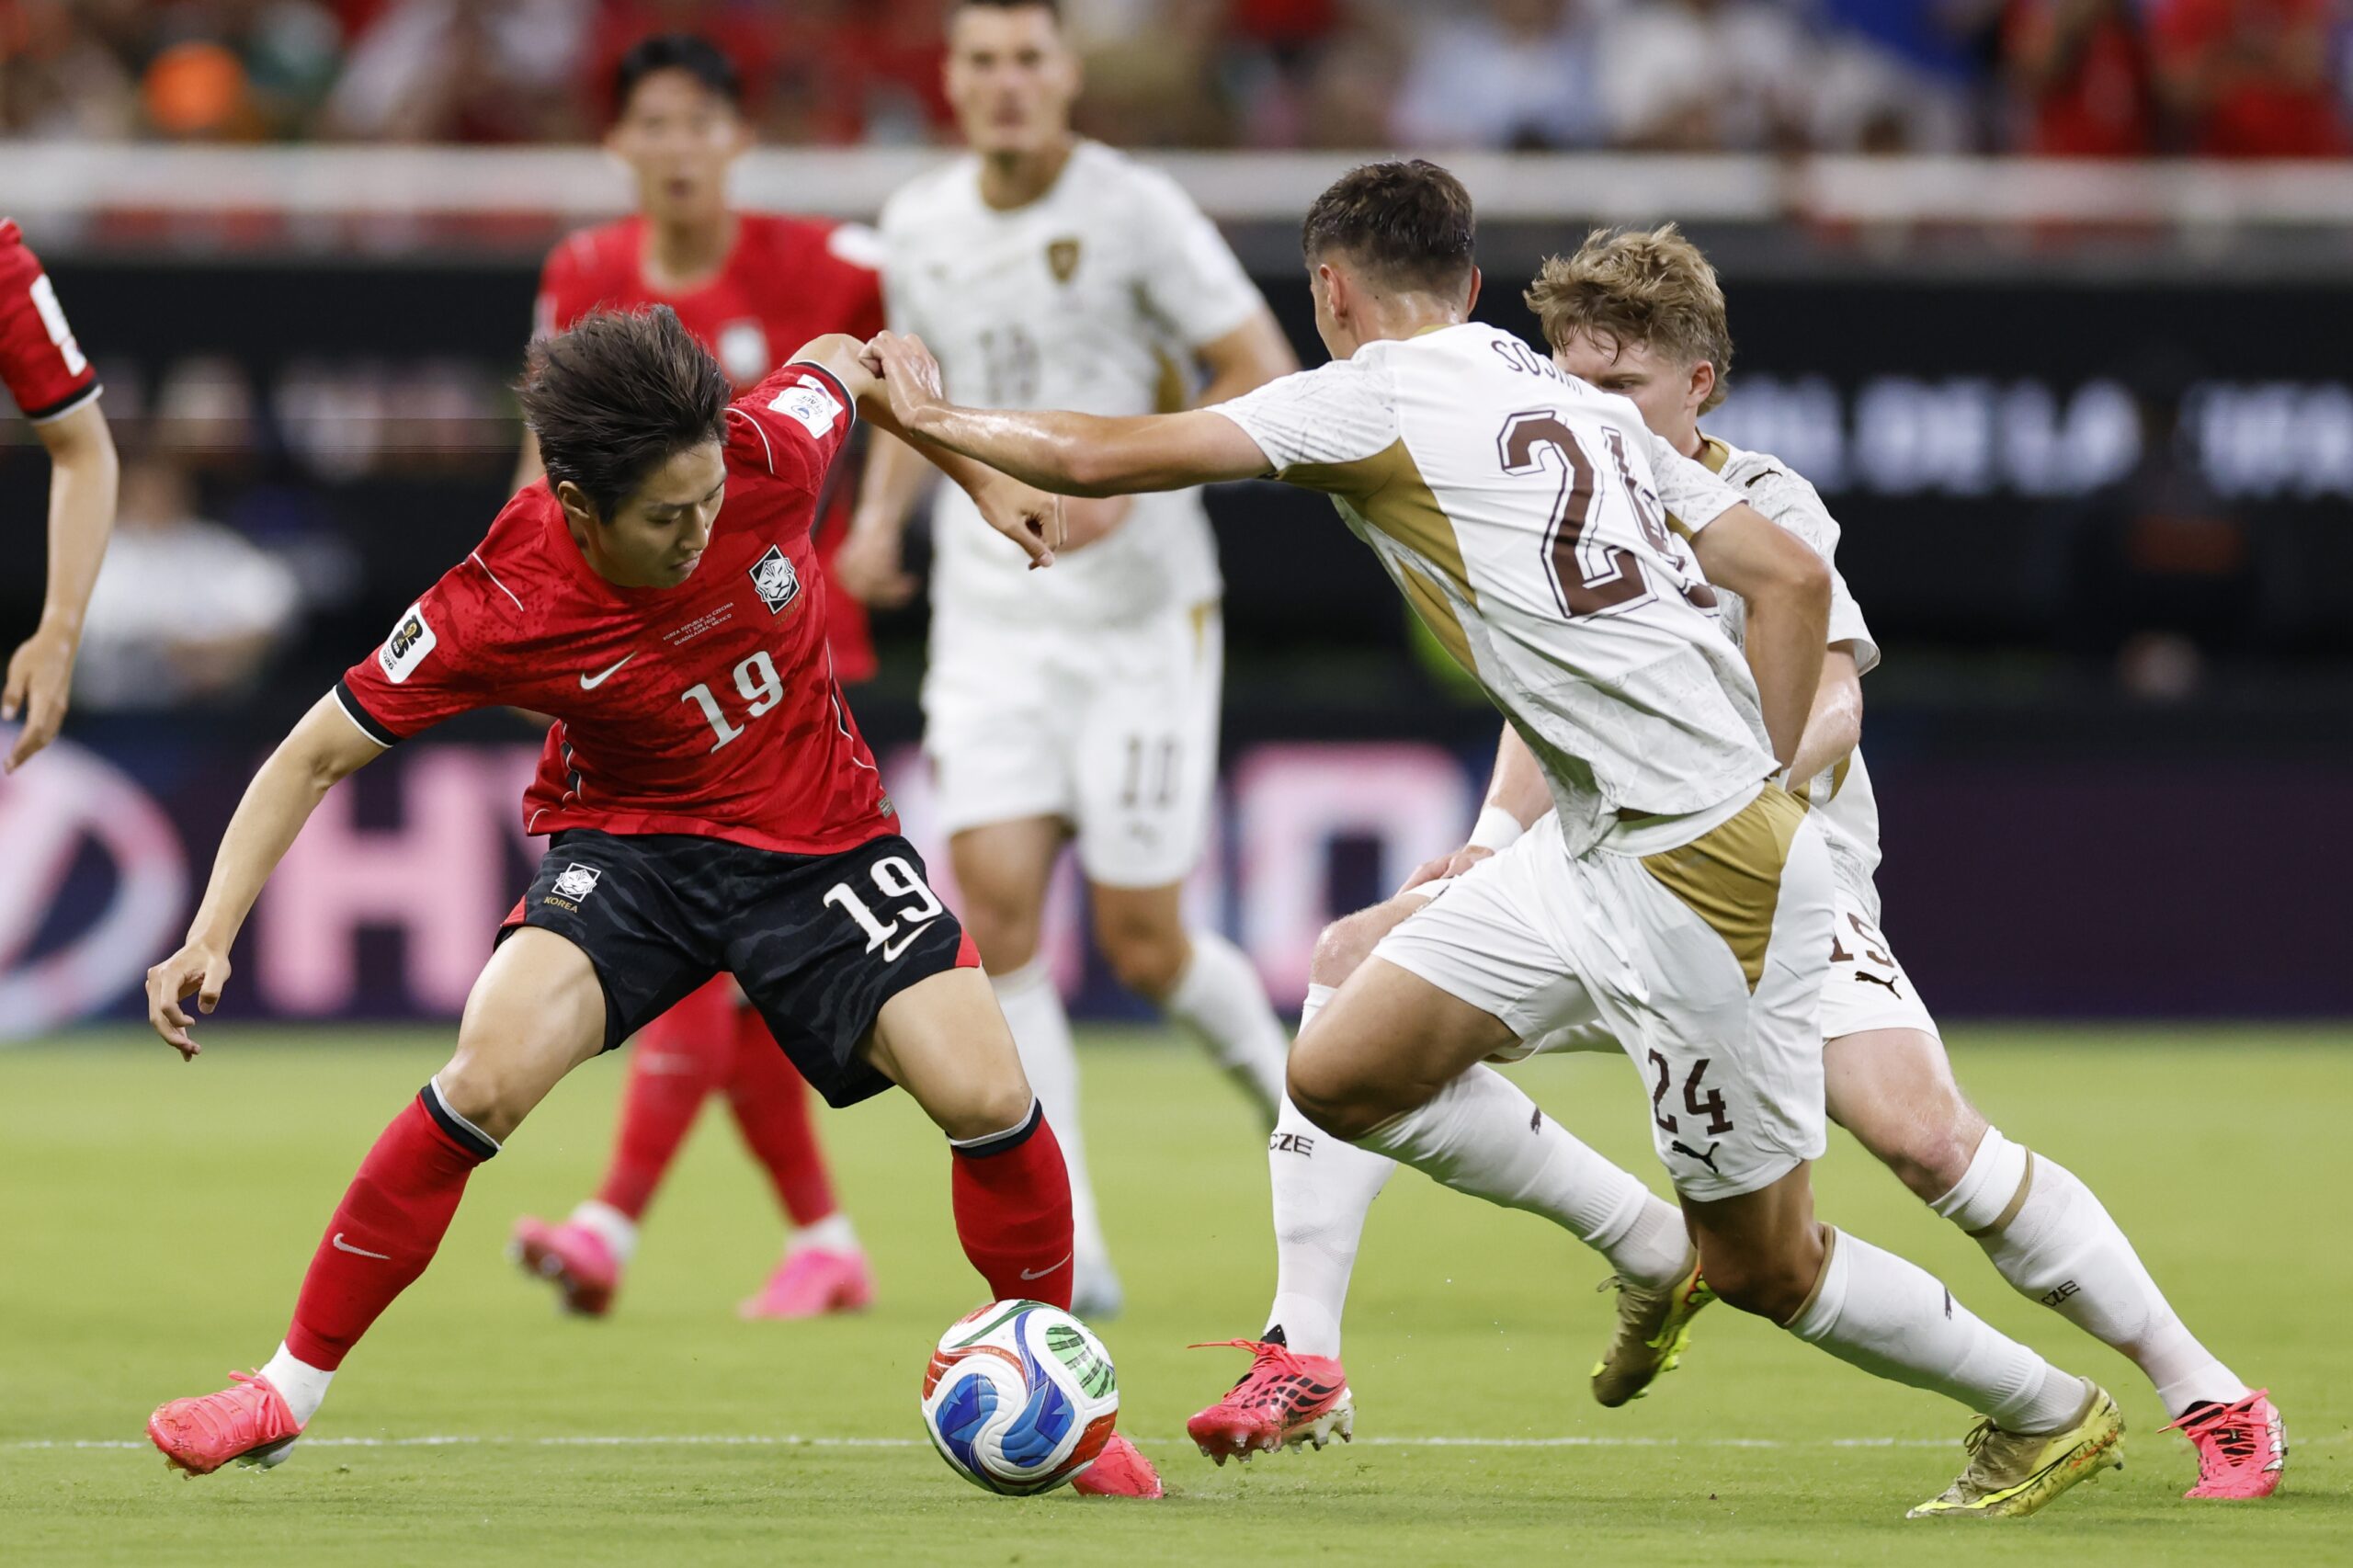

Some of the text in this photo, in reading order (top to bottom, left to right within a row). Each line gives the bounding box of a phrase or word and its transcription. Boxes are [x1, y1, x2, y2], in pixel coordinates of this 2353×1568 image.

[1496, 410, 1722, 623] 24
[663, 630, 680, 641] KOREA
[680, 618, 705, 631] REPUBLIC
[712, 602, 734, 616] CZECHIA
[711, 613, 733, 626] MEXICO
[681, 651, 784, 754] 19
[543, 896, 579, 914] KOREA
[823, 856, 944, 955] 19
[1648, 1048, 1734, 1135] 24
[1269, 1132, 1315, 1159] CZE
[2040, 1279, 2081, 1307] CZE
